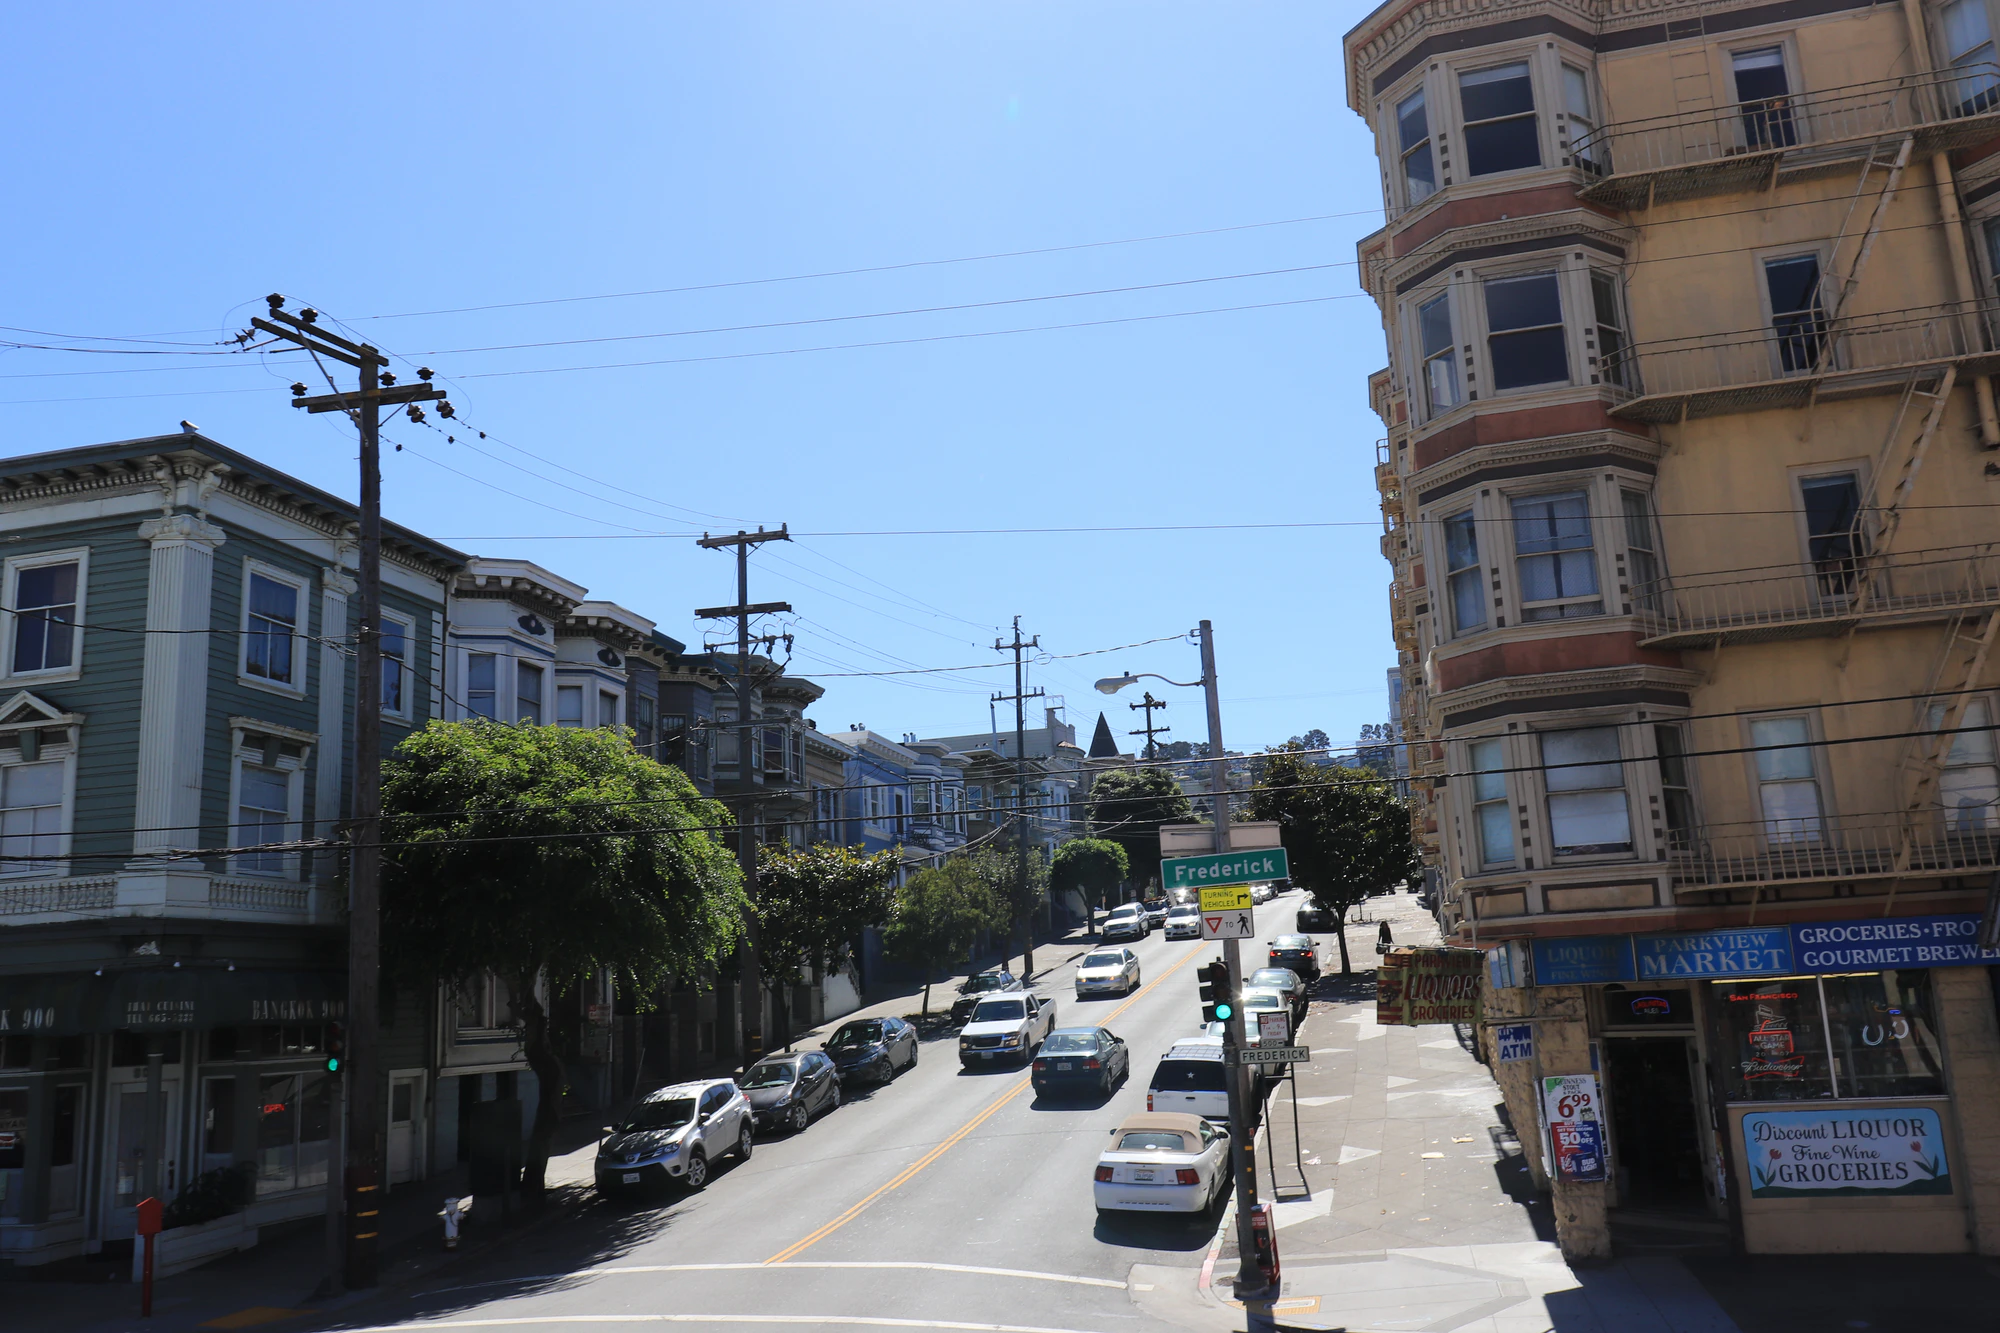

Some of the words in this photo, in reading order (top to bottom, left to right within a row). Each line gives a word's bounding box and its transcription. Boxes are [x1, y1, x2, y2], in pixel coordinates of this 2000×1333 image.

[1174, 857, 1275, 881] Frederick
[1204, 890, 1234, 898] TURNING
[1204, 900, 1235, 908] VEHICLES
[1225, 921, 1234, 929] TO
[1799, 923, 1921, 944] GROCERIES
[1931, 920, 1982, 937] FRO
[1654, 933, 1769, 953] PARKVIEW
[1547, 944, 1618, 965] LIQUOR
[1643, 948, 1786, 976] MARKET
[1803, 945, 1913, 967] GOURMET
[1404, 973, 1484, 1004] LIQUORS
[1749, 992, 1799, 1001] FRANCISCO
[22, 1007, 55, 1030] 900
[252, 1000, 314, 1020] BANGKOK
[322, 1000, 345, 1018] 900
[1411, 1005, 1475, 1021] GROCERIES
[1501, 1042, 1532, 1060] ATM
[1760, 1041, 1785, 1049] GAME
[1242, 1049, 1306, 1062] FREDERICK
[1741, 1060, 1803, 1073] Budweiser
[1554, 1077, 1587, 1086] GUINNESS
[263, 1103, 285, 1113] OPEN
[1560, 1131, 1581, 1145] 50
[1753, 1120, 1829, 1143] Discount
[1831, 1118, 1928, 1141] LIQUOR
[1792, 1144, 1832, 1162] Fine
[1832, 1144, 1880, 1160] Wine
[1778, 1161, 1909, 1183] GROCERIES
